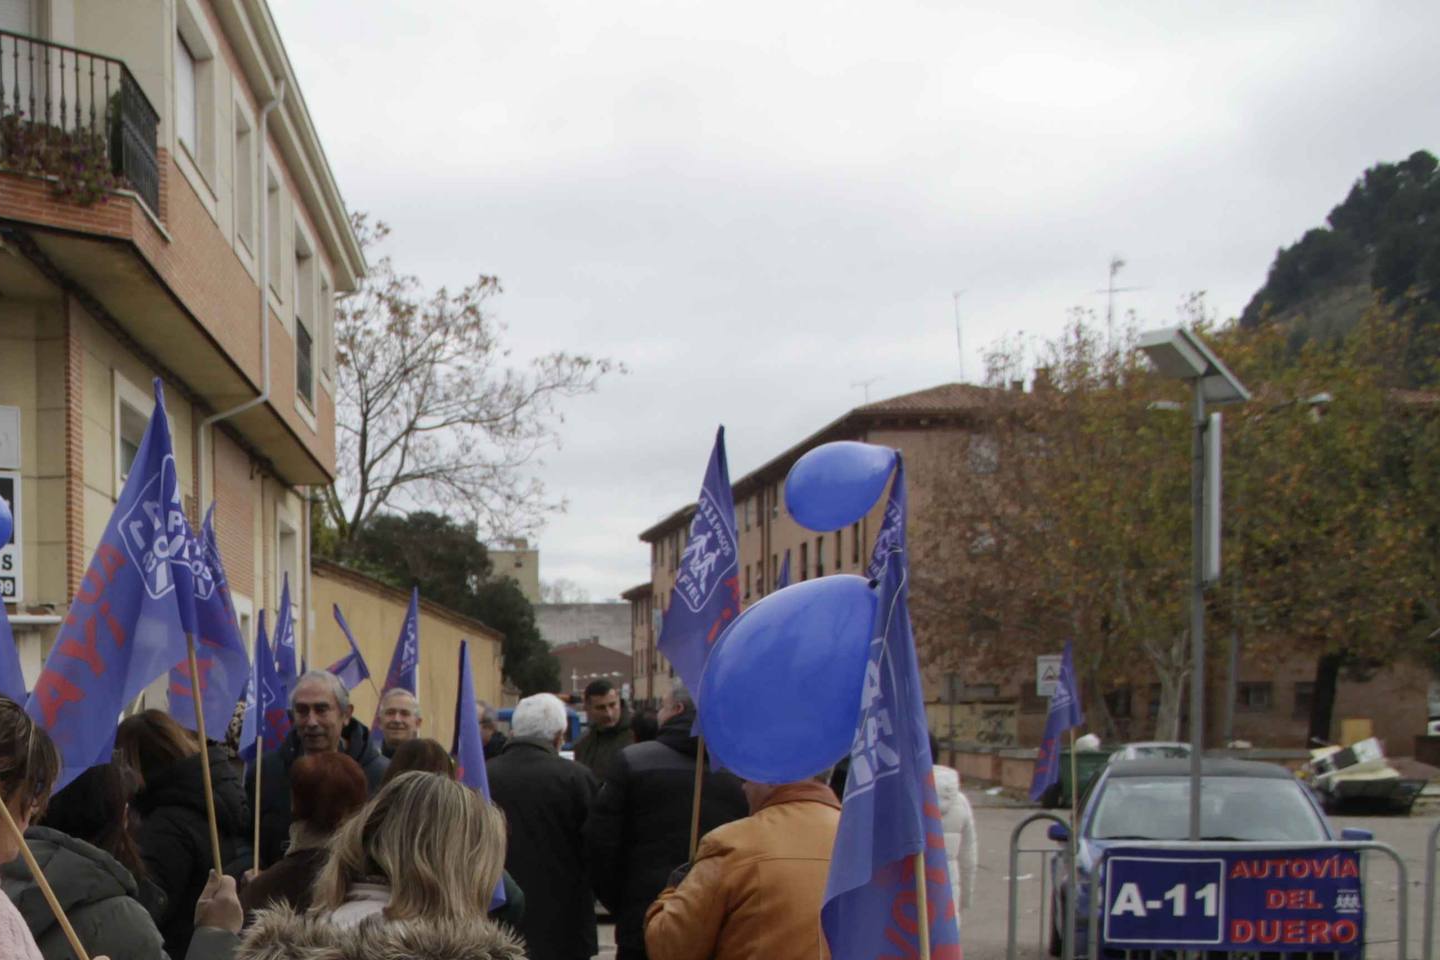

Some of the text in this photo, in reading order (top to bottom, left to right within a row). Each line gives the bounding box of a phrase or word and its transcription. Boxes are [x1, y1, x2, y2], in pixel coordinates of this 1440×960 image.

[1230, 854, 1360, 879] AUTOVÍA
[1110, 882, 1218, 917] A-11
[1266, 889, 1324, 909] DEL
[1231, 919, 1359, 944] DUERO
